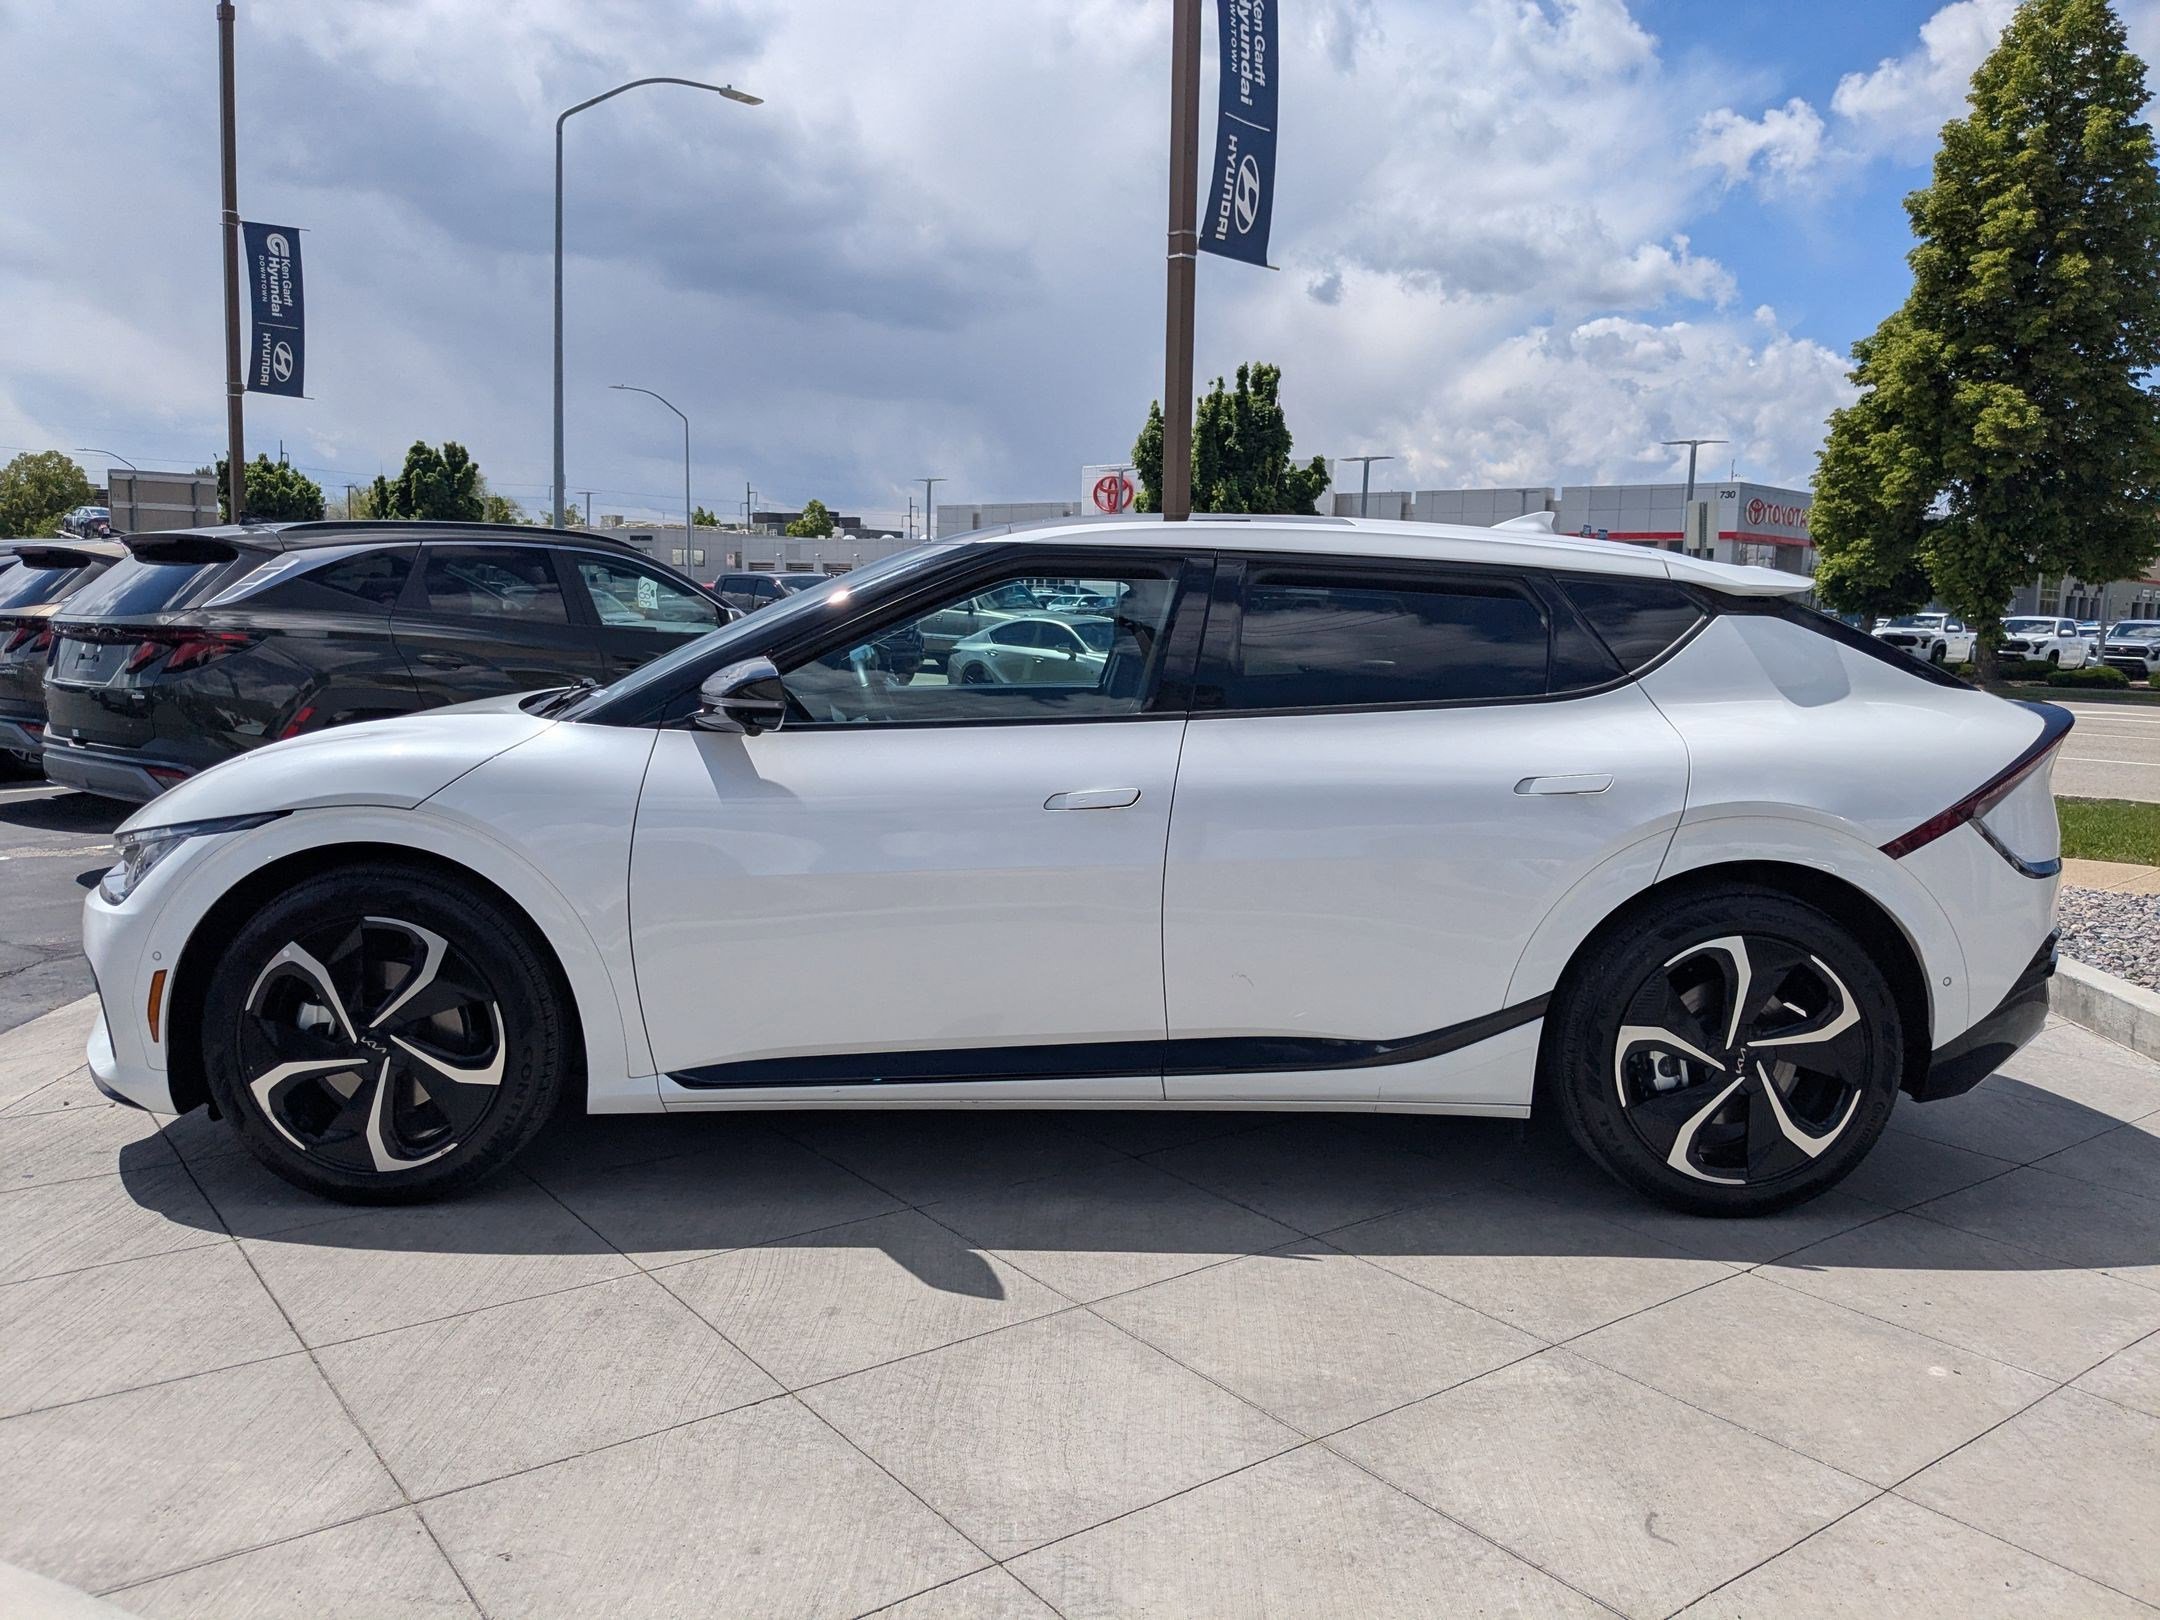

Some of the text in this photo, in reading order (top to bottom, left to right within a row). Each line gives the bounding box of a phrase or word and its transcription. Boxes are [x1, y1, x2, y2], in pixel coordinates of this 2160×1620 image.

[1254, 34, 1266, 87] Garff
[1215, 134, 1238, 241] HYUNDAI
[258, 255, 267, 302] DOWNTOWN
[266, 257, 283, 317] Hyundai
[281, 258, 293, 306] Ken Garff
[260, 333, 272, 386] HYUNDAI
[1720, 491, 1736, 499] 730
[1765, 504, 1807, 528] TOYOTA
